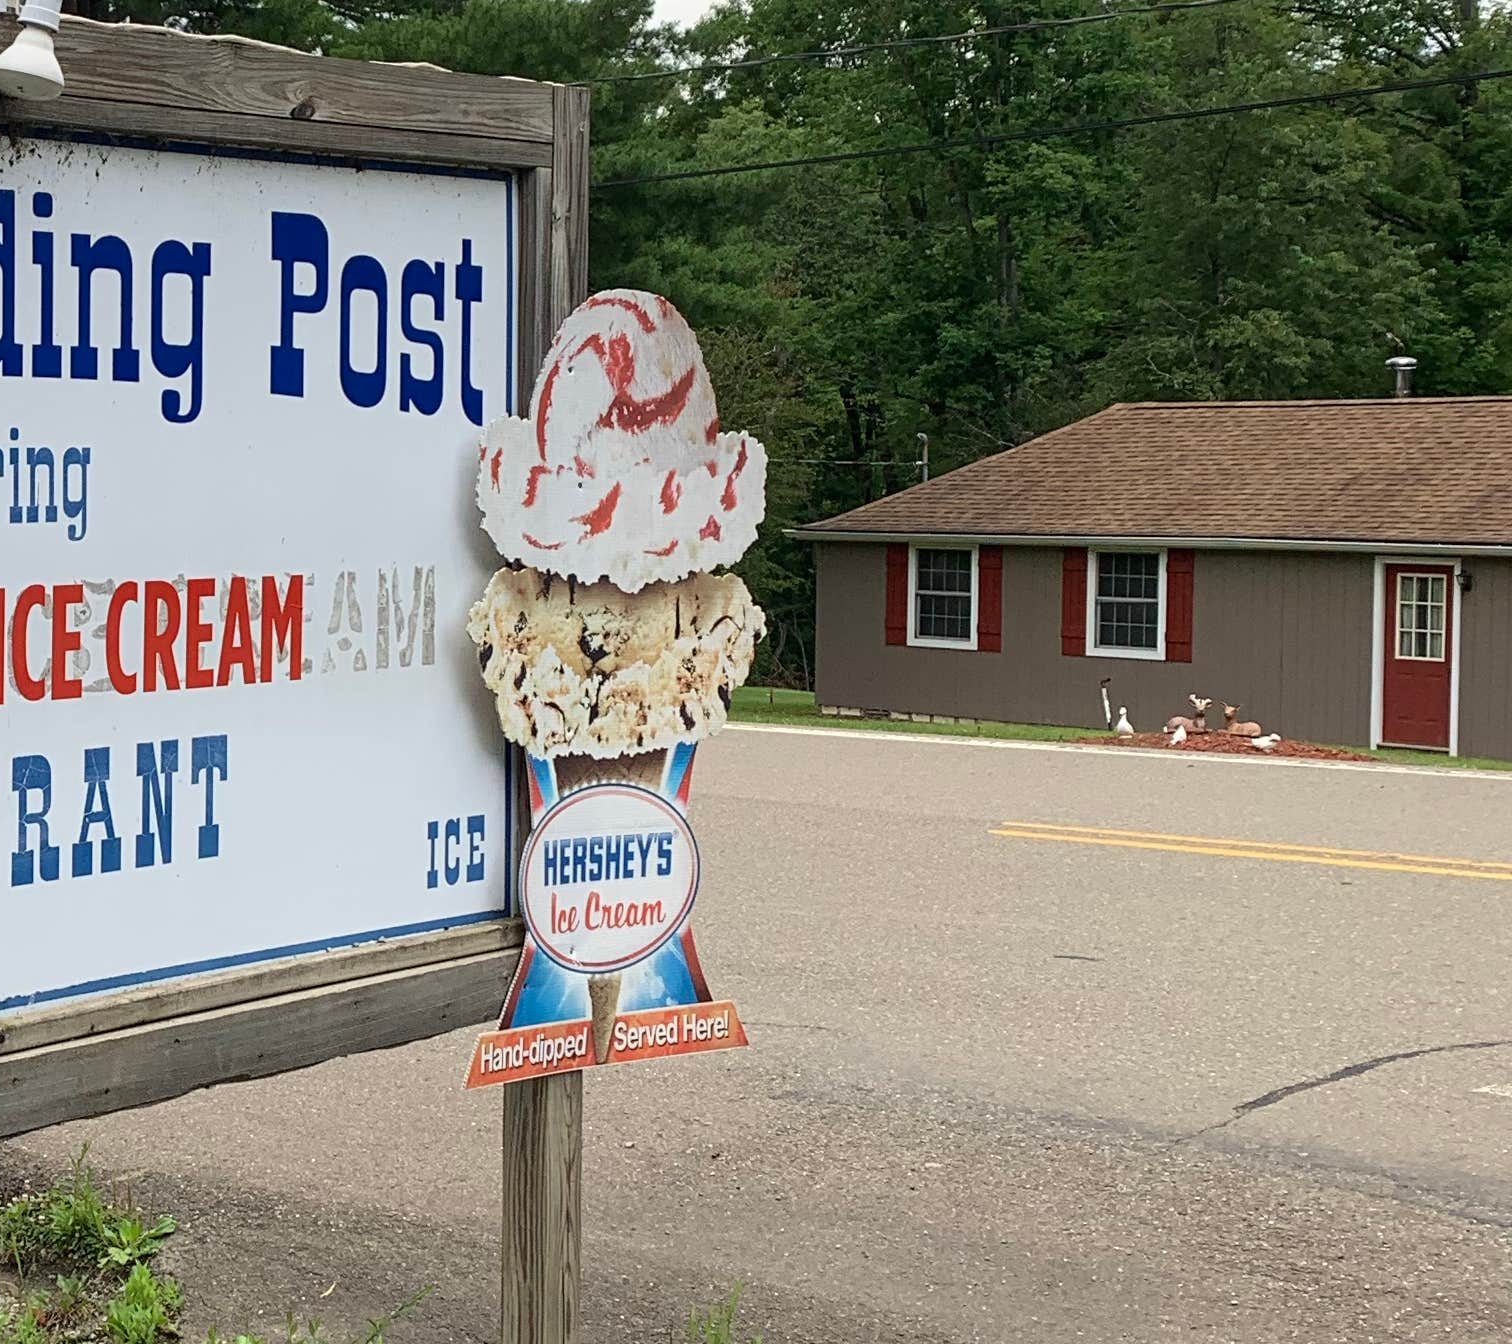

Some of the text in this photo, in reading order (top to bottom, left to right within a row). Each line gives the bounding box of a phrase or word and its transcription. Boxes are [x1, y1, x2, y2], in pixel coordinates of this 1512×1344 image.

[270, 210, 484, 427] Post
[104, 573, 306, 696] CREAM
[426, 813, 486, 889] ICE
[550, 890, 667, 935] Ice Cream
[479, 1009, 730, 1074] Hand-dipped Served Here!
